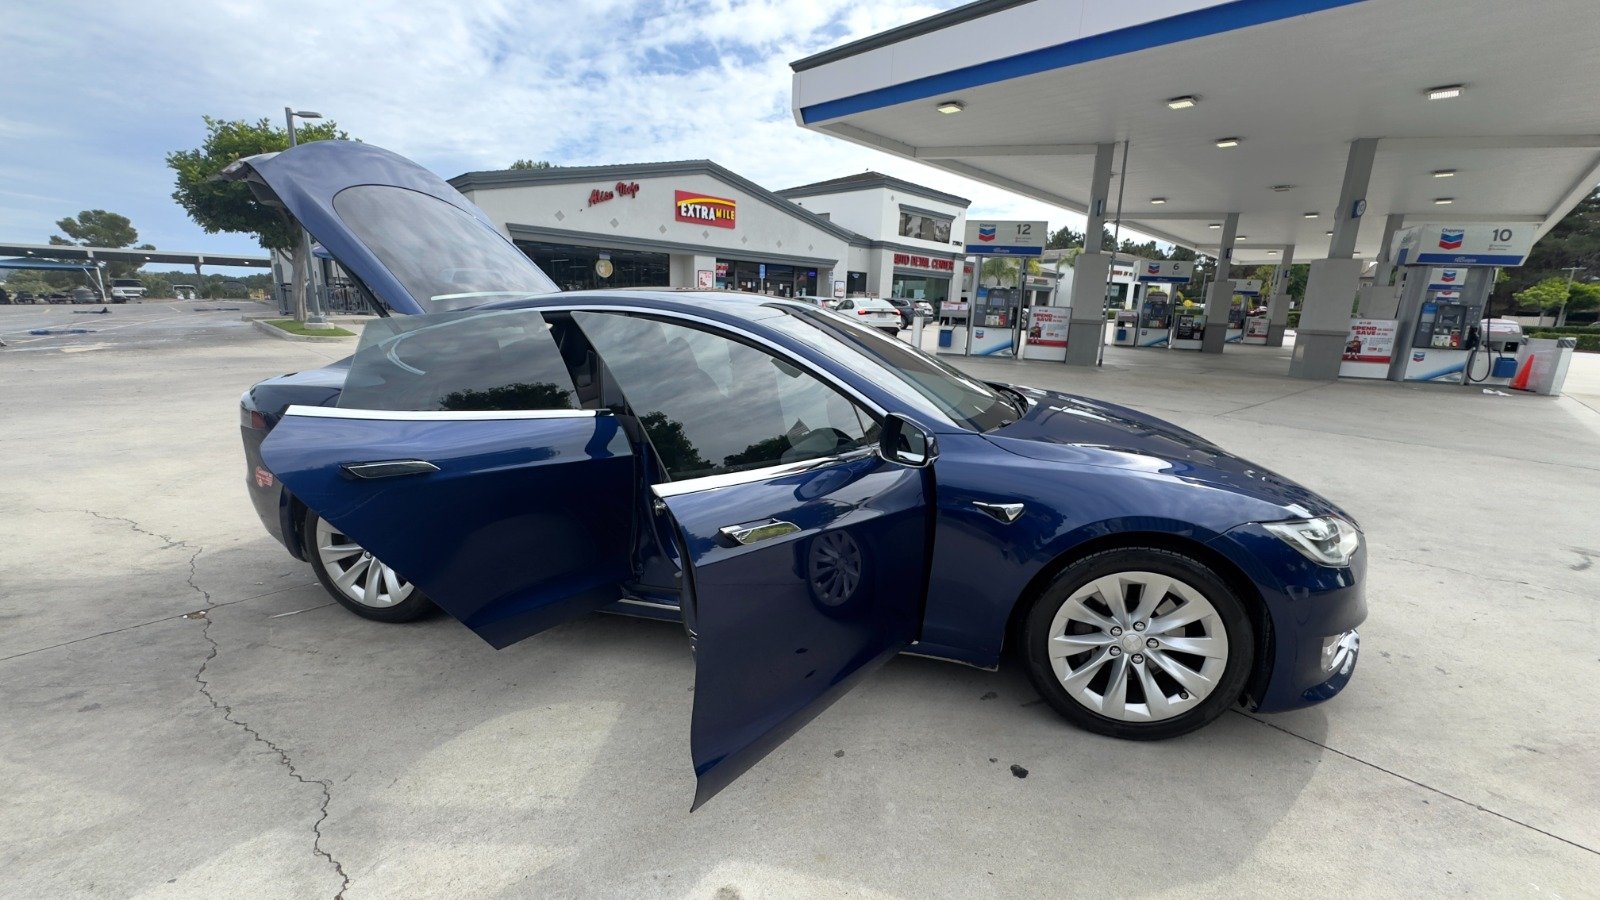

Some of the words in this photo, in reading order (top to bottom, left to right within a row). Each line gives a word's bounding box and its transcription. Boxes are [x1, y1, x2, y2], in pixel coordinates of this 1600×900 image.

[588, 189, 614, 207] Aliso
[615, 181, 640, 199] Viejo
[1016, 223, 1032, 235] 12
[1492, 228, 1513, 242] 10
[894, 253, 910, 266] AUTO
[910, 255, 930, 268] DETAIL
[931, 258, 954, 271] CENTER
[1173, 262, 1180, 271] 6
